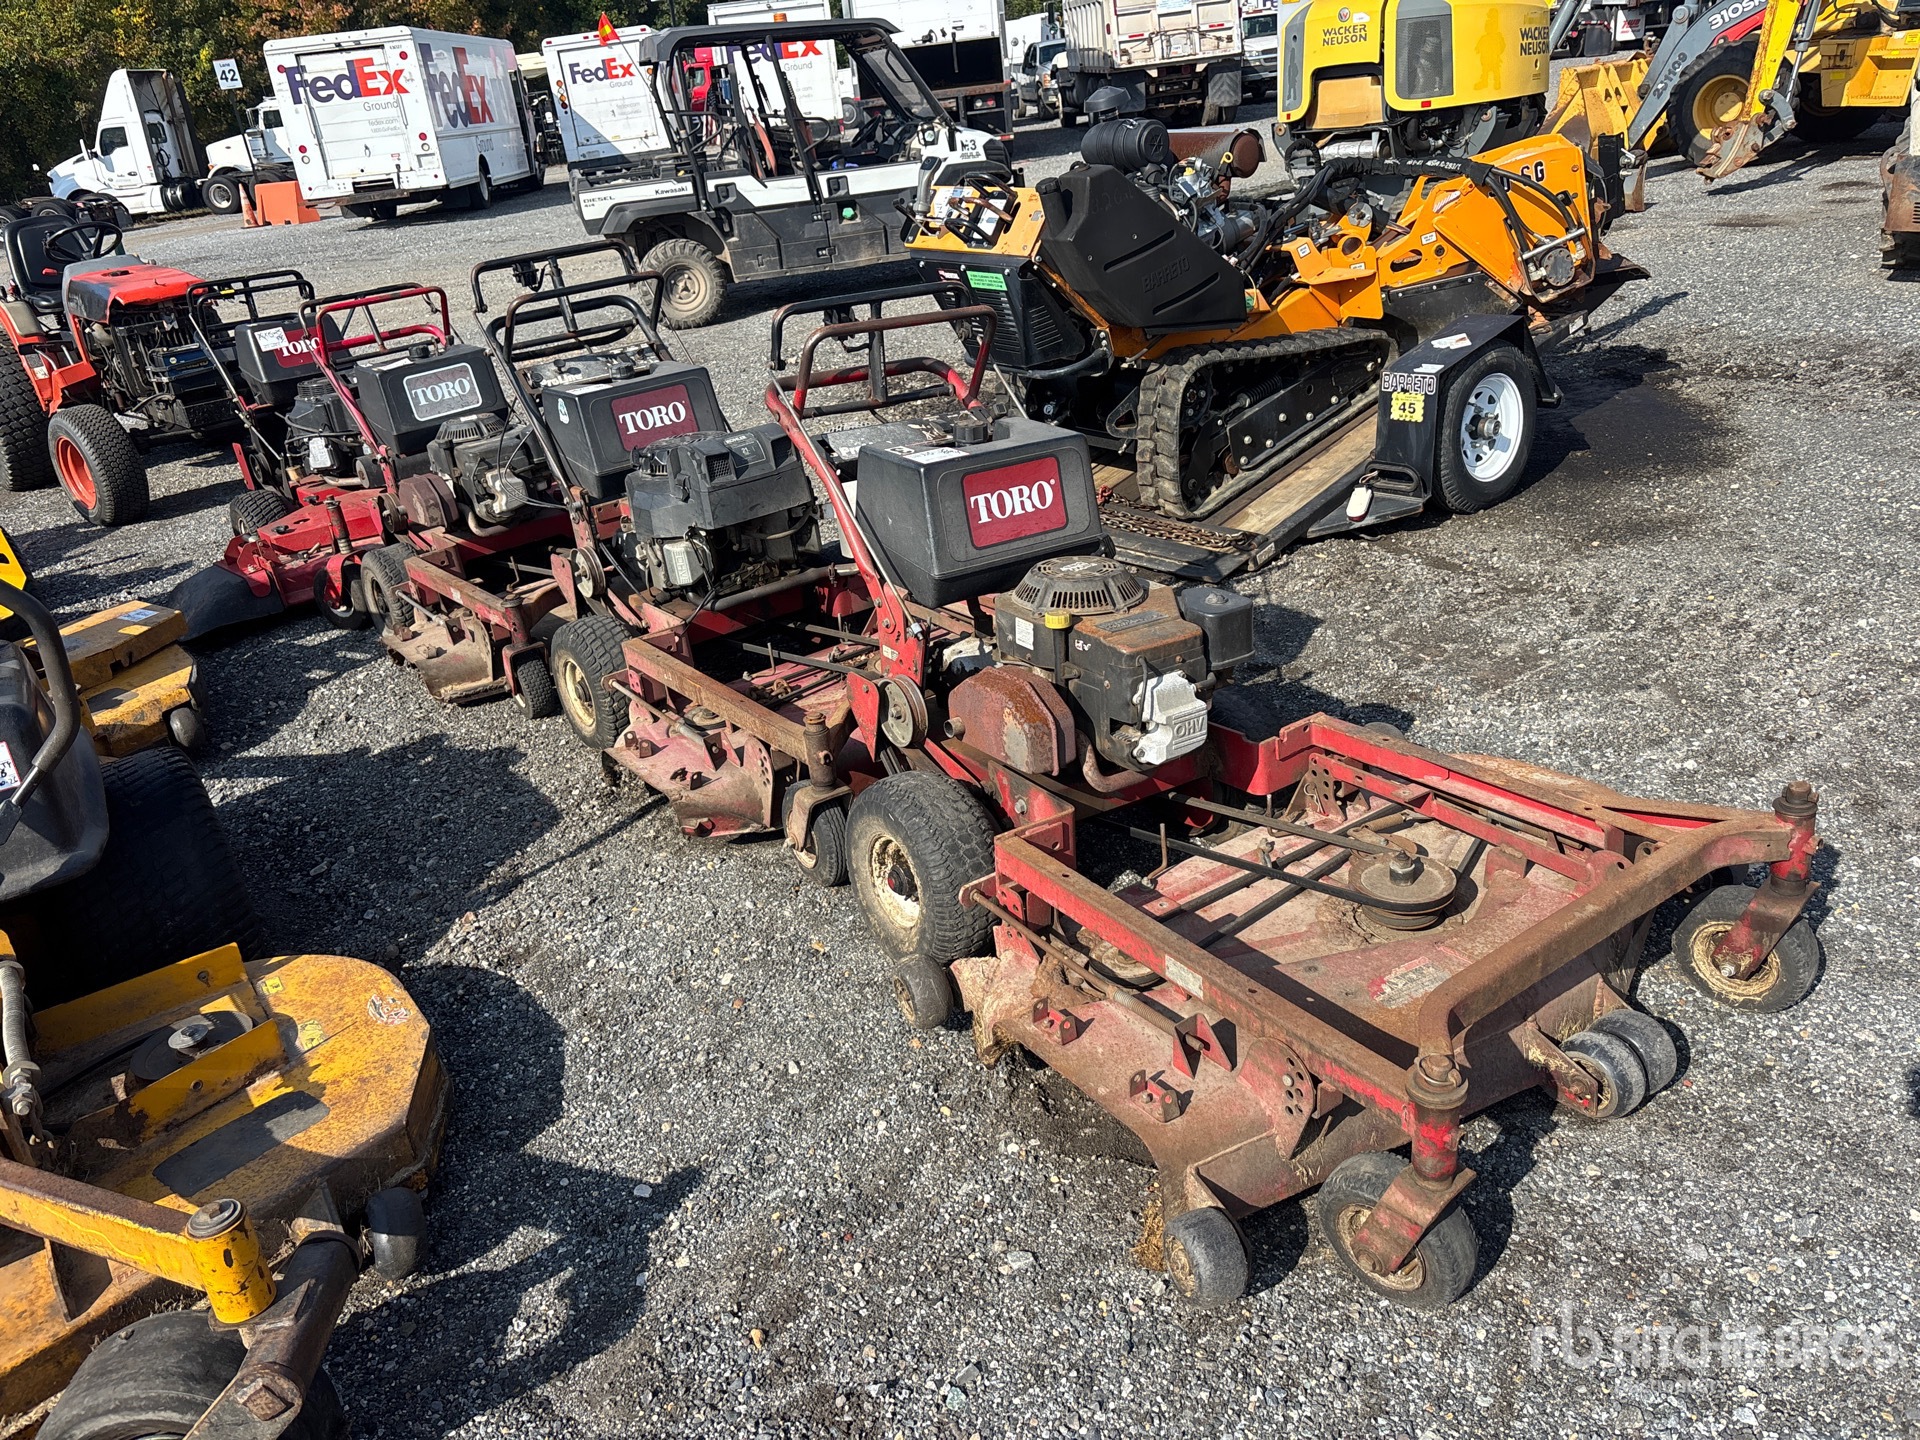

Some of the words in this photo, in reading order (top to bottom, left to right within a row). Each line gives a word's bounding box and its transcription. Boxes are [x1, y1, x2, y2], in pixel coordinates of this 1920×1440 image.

[1708, 0, 1767, 30] 310S
[1322, 24, 1367, 37] WACKER
[1322, 33, 1367, 46] NEUSON
[1519, 26, 1549, 41] WACKER
[220, 68, 239, 82] 42
[568, 57, 636, 85] FedEx
[784, 61, 813, 71] Ground
[285, 57, 410, 105] FedEx
[418, 43, 494, 128] FedEx
[609, 80, 633, 88] Ground
[363, 99, 399, 112] Ground
[655, 186, 688, 195] Kawasaki
[412, 378, 470, 406] TORO
[1382, 371, 1436, 395] BARRETO
[1398, 402, 1416, 414] 45
[618, 401, 687, 434] TORO
[970, 480, 1054, 524] TORO
[1174, 717, 1205, 738] OHV
